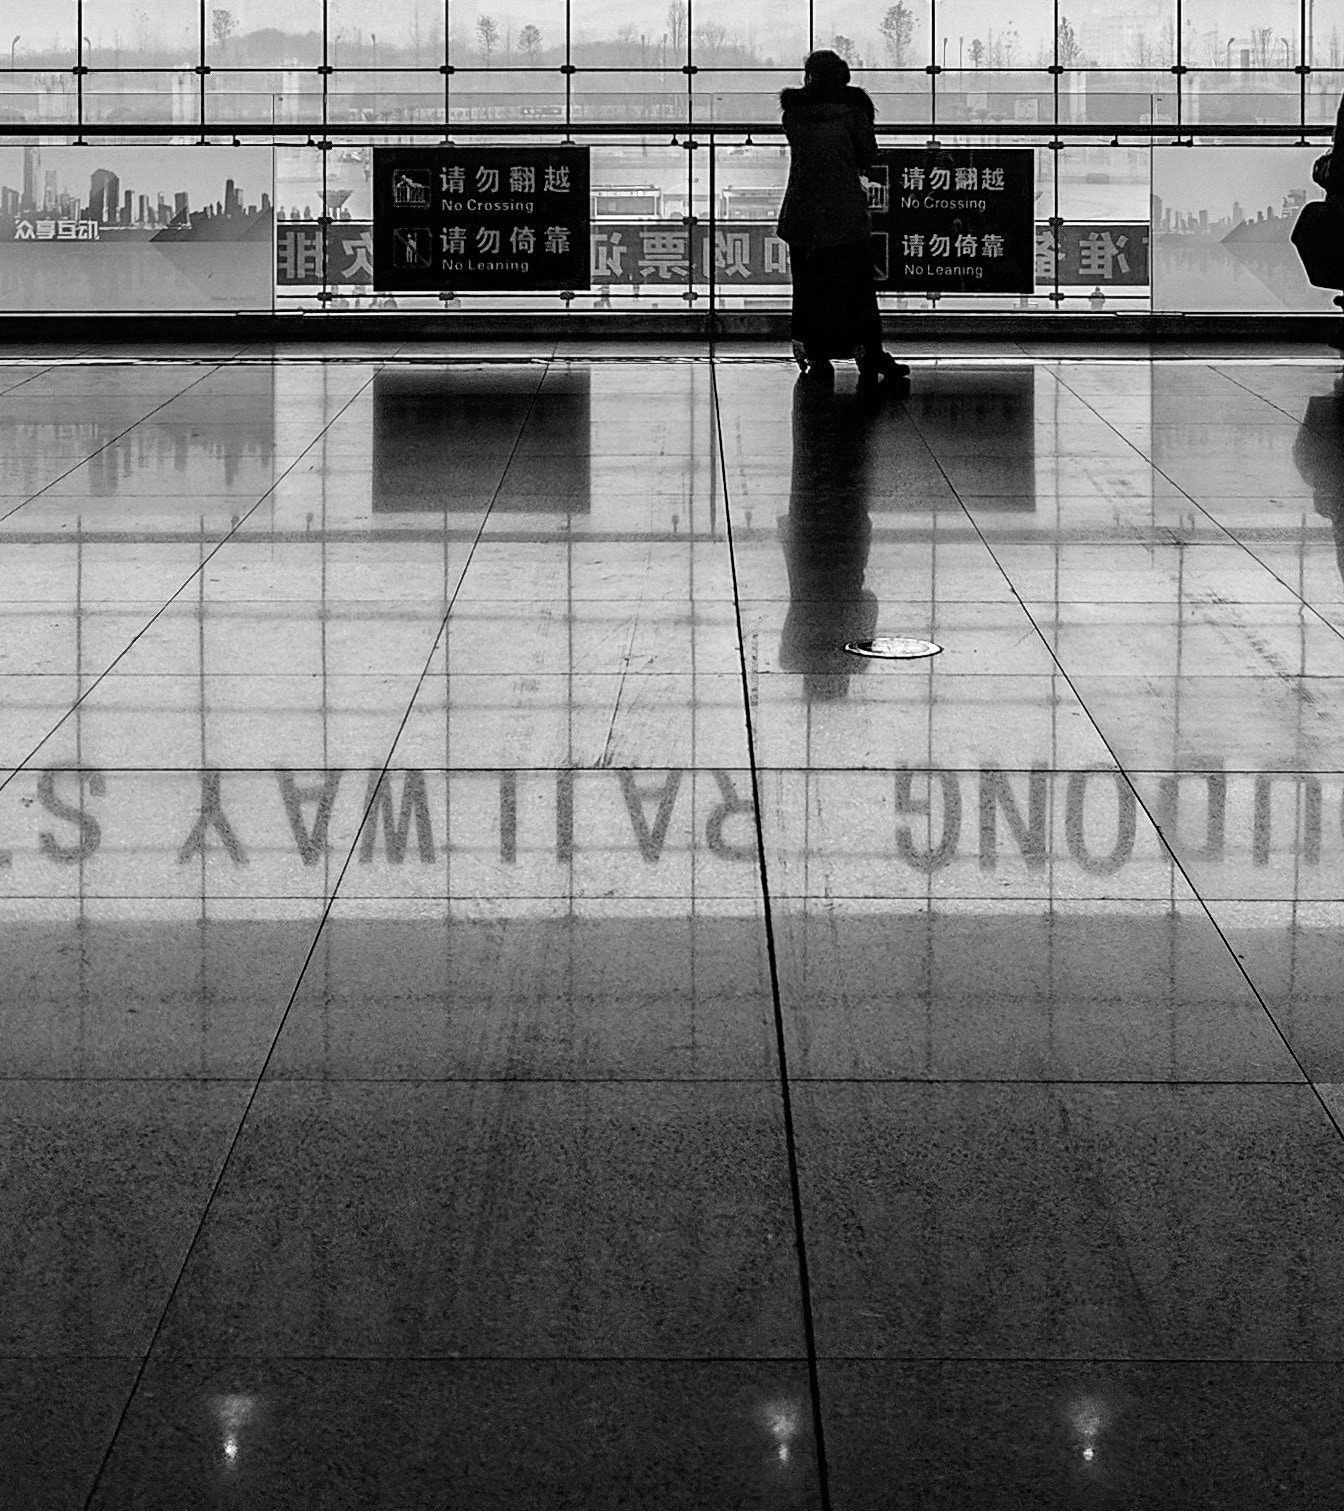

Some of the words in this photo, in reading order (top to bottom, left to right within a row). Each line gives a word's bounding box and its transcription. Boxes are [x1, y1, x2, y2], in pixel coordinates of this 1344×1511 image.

[439, 165, 571, 194] 请勿翻越
[901, 166, 1006, 192] 请勿翻越
[442, 199, 463, 212] No
[466, 198, 534, 214] Crossing
[900, 196, 920, 209] No
[923, 195, 987, 212] Crossing
[13, 219, 101, 241] 众享互动
[439, 225, 571, 255] 请勿倚靠
[901, 233, 1006, 258] 请勿倚靠
[442, 259, 463, 271] No
[467, 259, 529, 273] Leaning
[903, 264, 924, 276] No
[927, 264, 984, 279] Leaning
